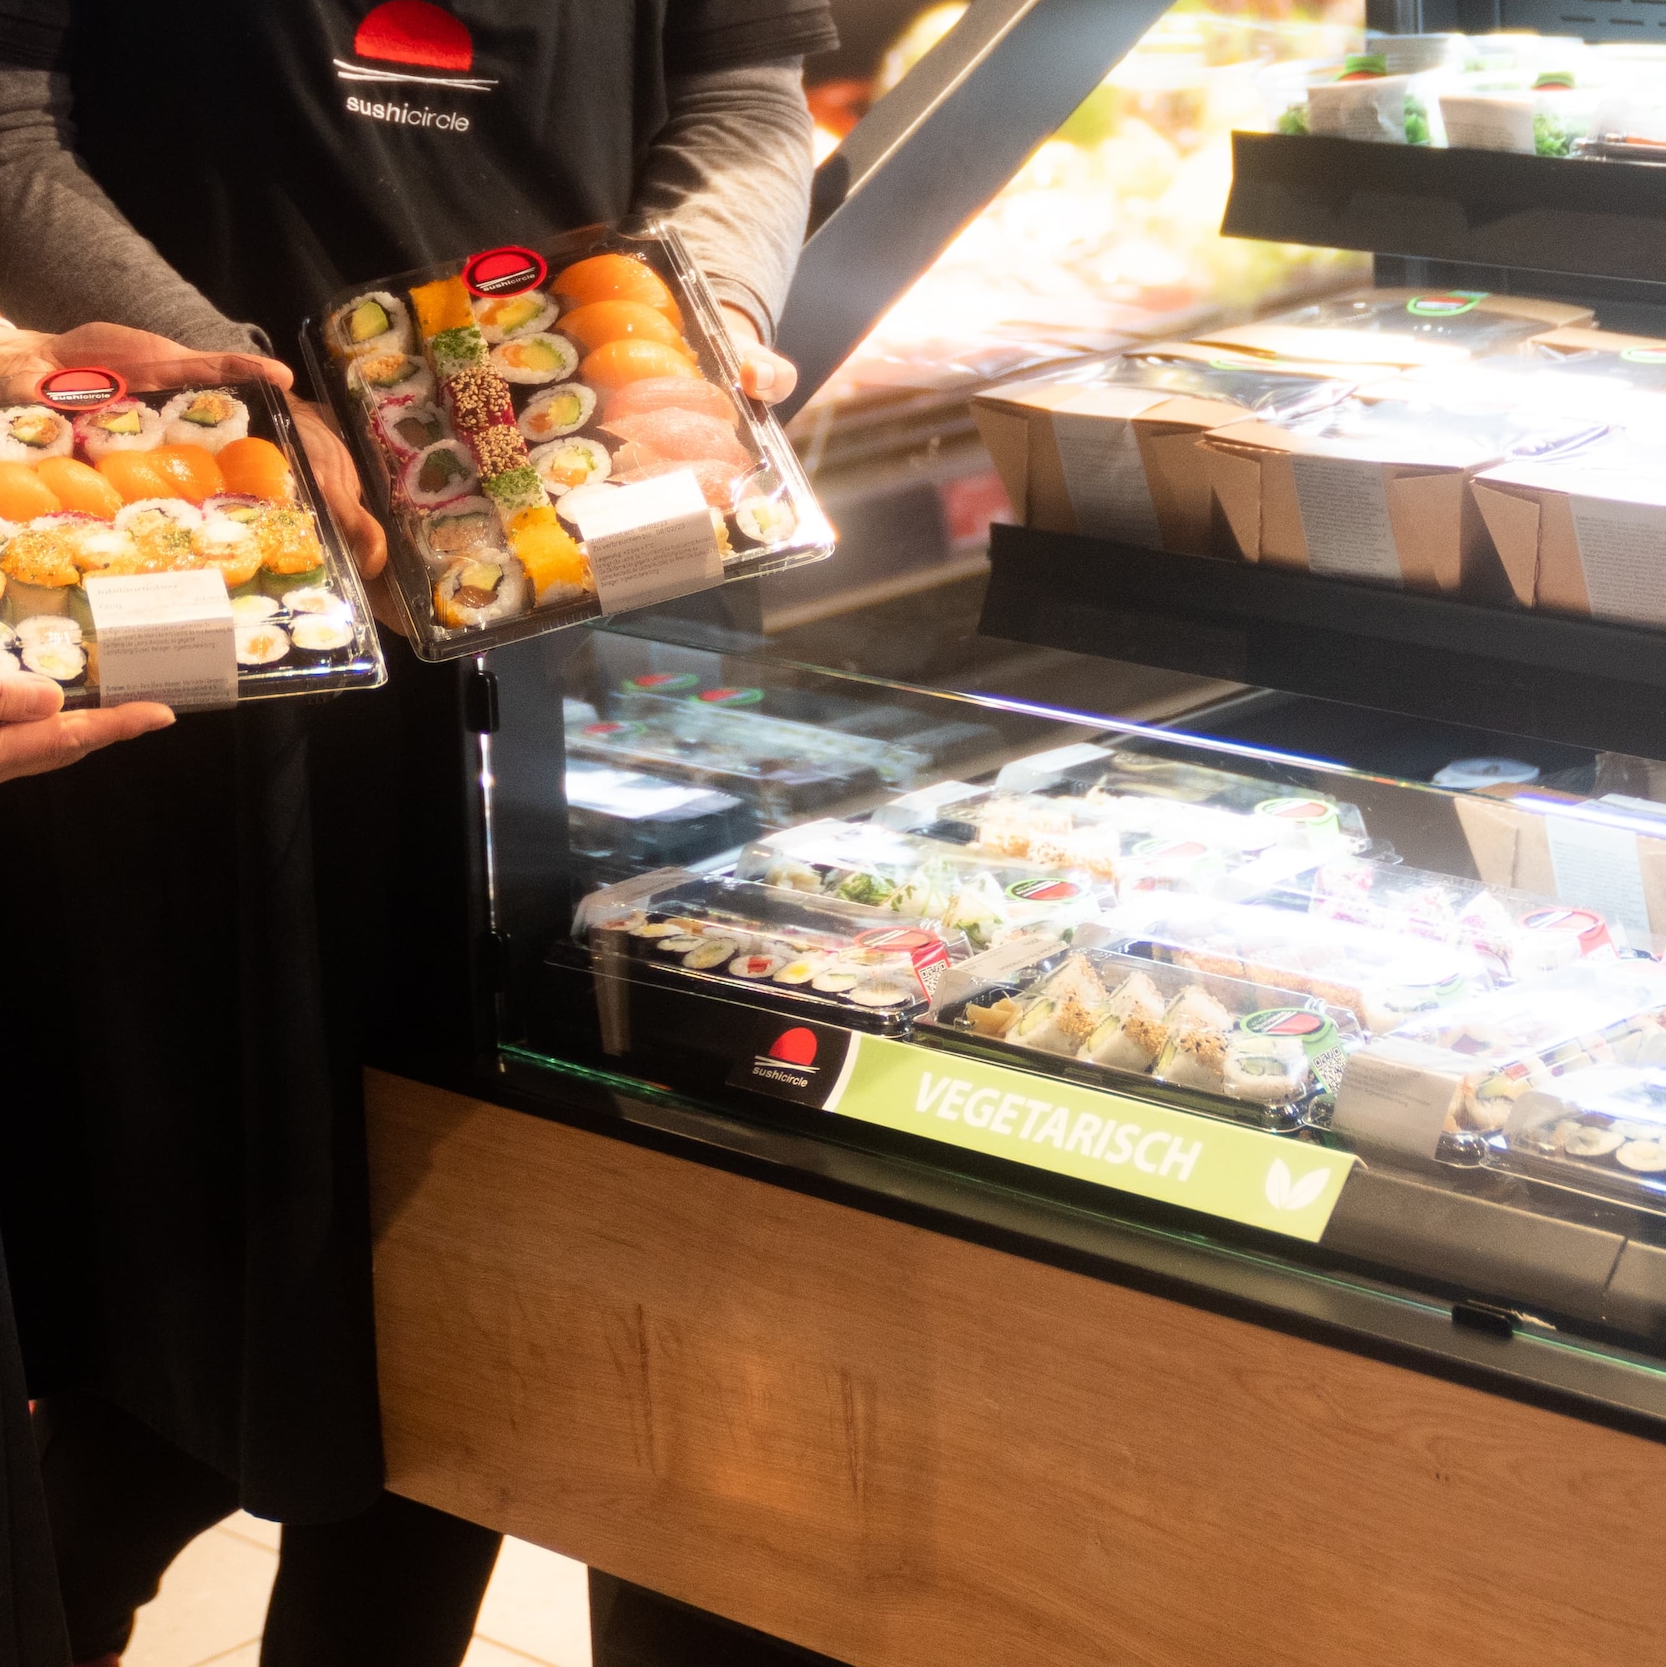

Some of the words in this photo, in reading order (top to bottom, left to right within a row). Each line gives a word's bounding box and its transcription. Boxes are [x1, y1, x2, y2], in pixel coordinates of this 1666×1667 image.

[346, 95, 470, 132] sushicircle
[483, 273, 536, 292] sushicircle
[52, 393, 111, 401] sushicircle
[752, 1064, 809, 1089] sushicircle
[913, 1069, 1204, 1183] VEGETARISCH
